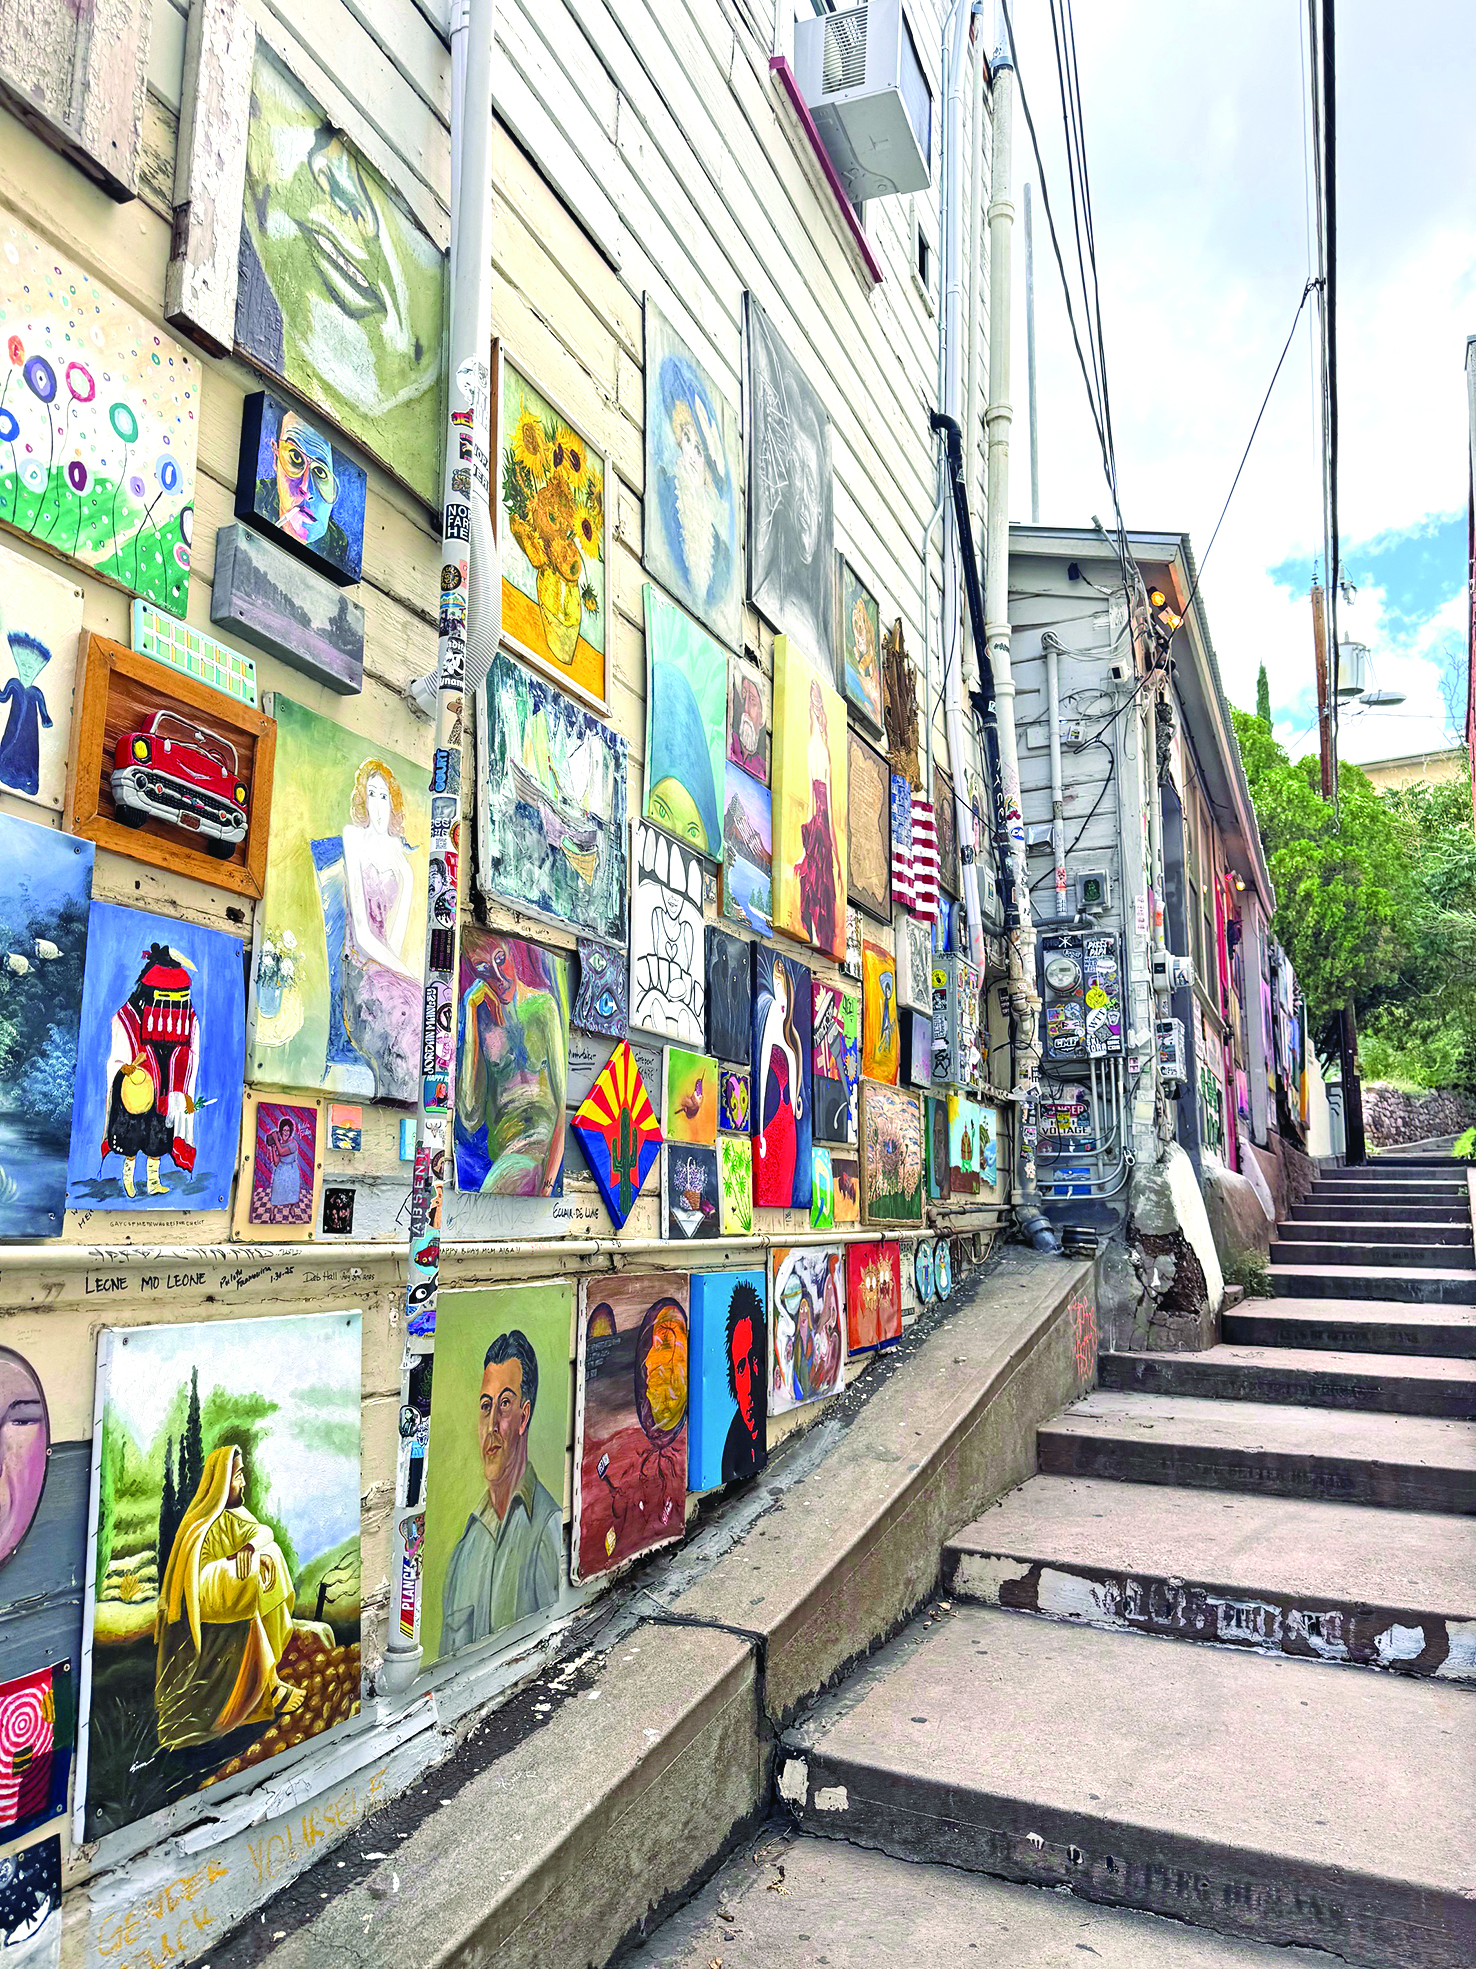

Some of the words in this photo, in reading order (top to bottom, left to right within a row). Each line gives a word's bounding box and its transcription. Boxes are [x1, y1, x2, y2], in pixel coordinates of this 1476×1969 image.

[1042, 1126, 1088, 1135] VOTAGE
[141, 1276, 160, 1291] MO
[167, 1272, 206, 1289] LEONE
[323, 1270, 338, 1281] Hall
[402, 1564, 416, 1611] PLANCK
